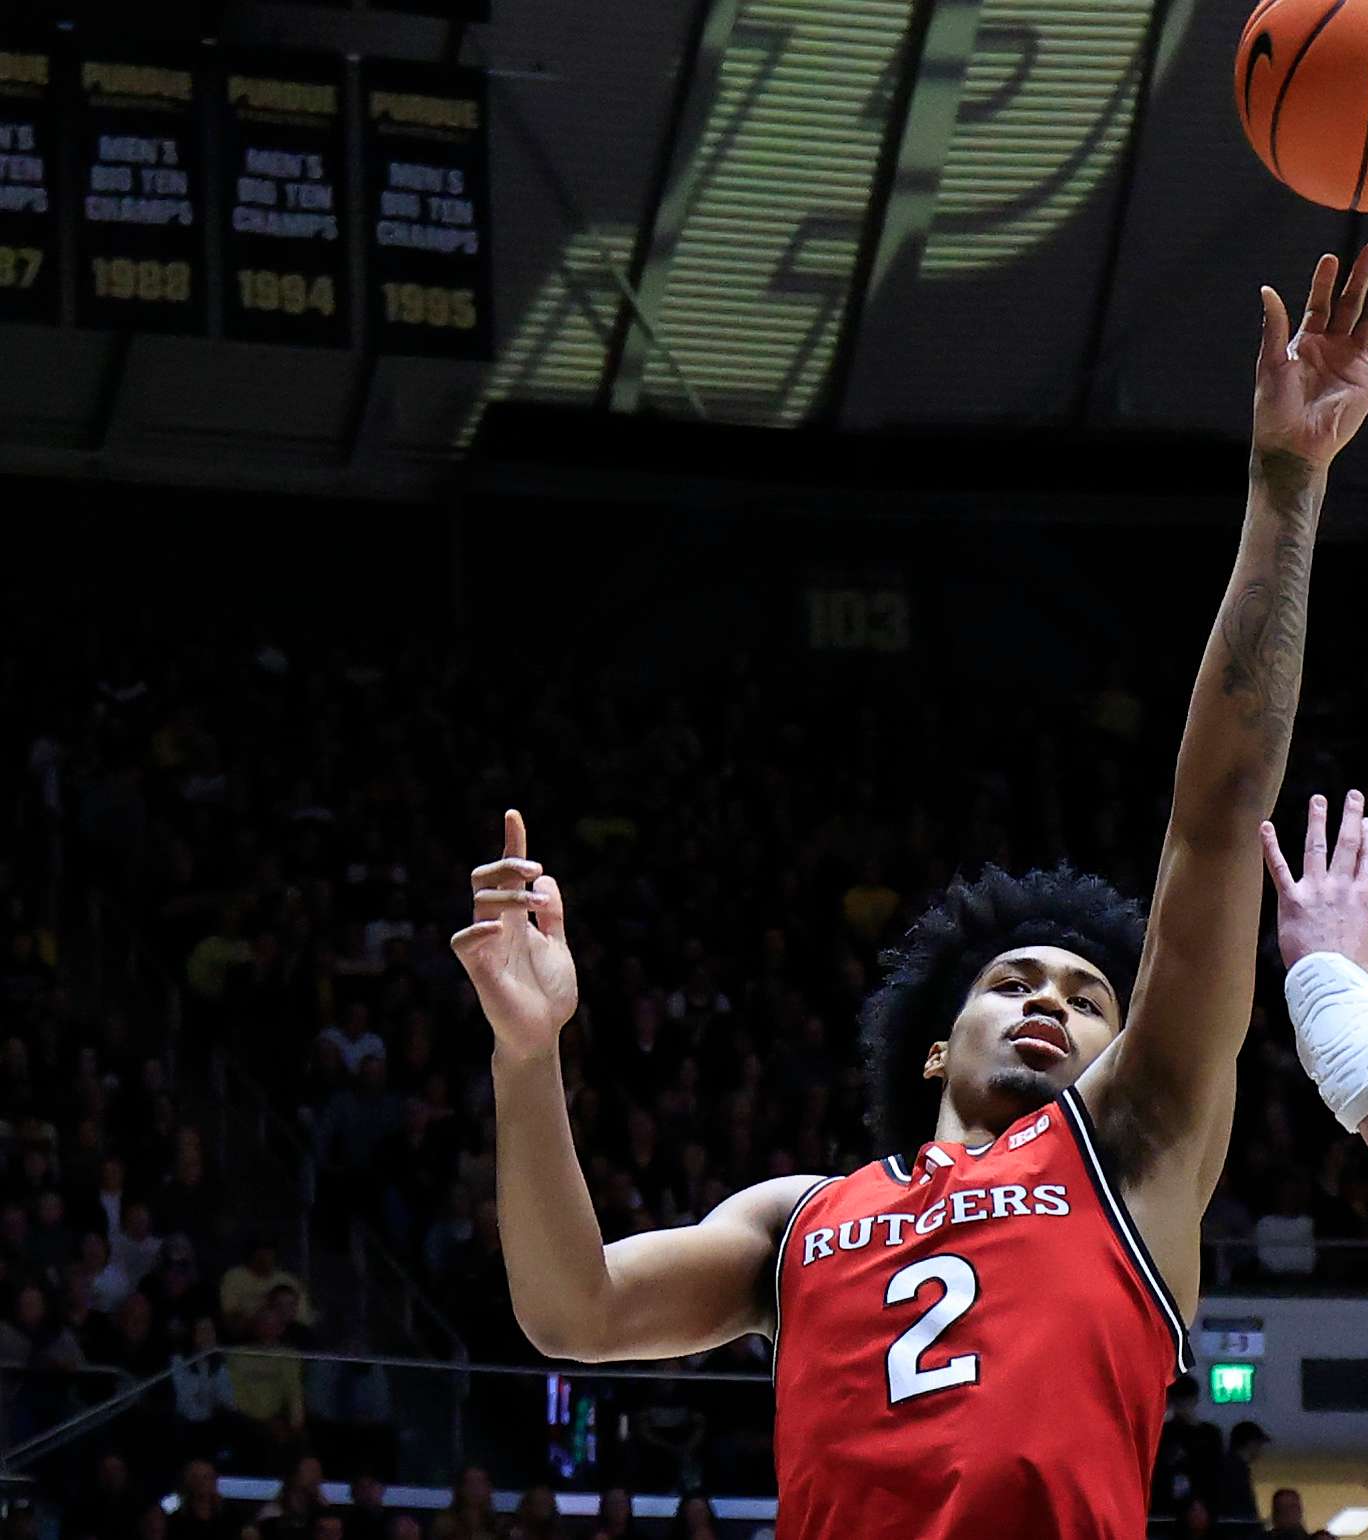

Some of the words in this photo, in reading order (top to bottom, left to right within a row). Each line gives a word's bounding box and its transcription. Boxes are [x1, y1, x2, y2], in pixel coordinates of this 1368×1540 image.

[91, 256, 191, 303] 1988
[237, 268, 336, 317] 1994
[381, 282, 478, 330] 1995
[802, 1184, 1072, 1267] RUTGERS
[883, 1252, 981, 1408] 2
